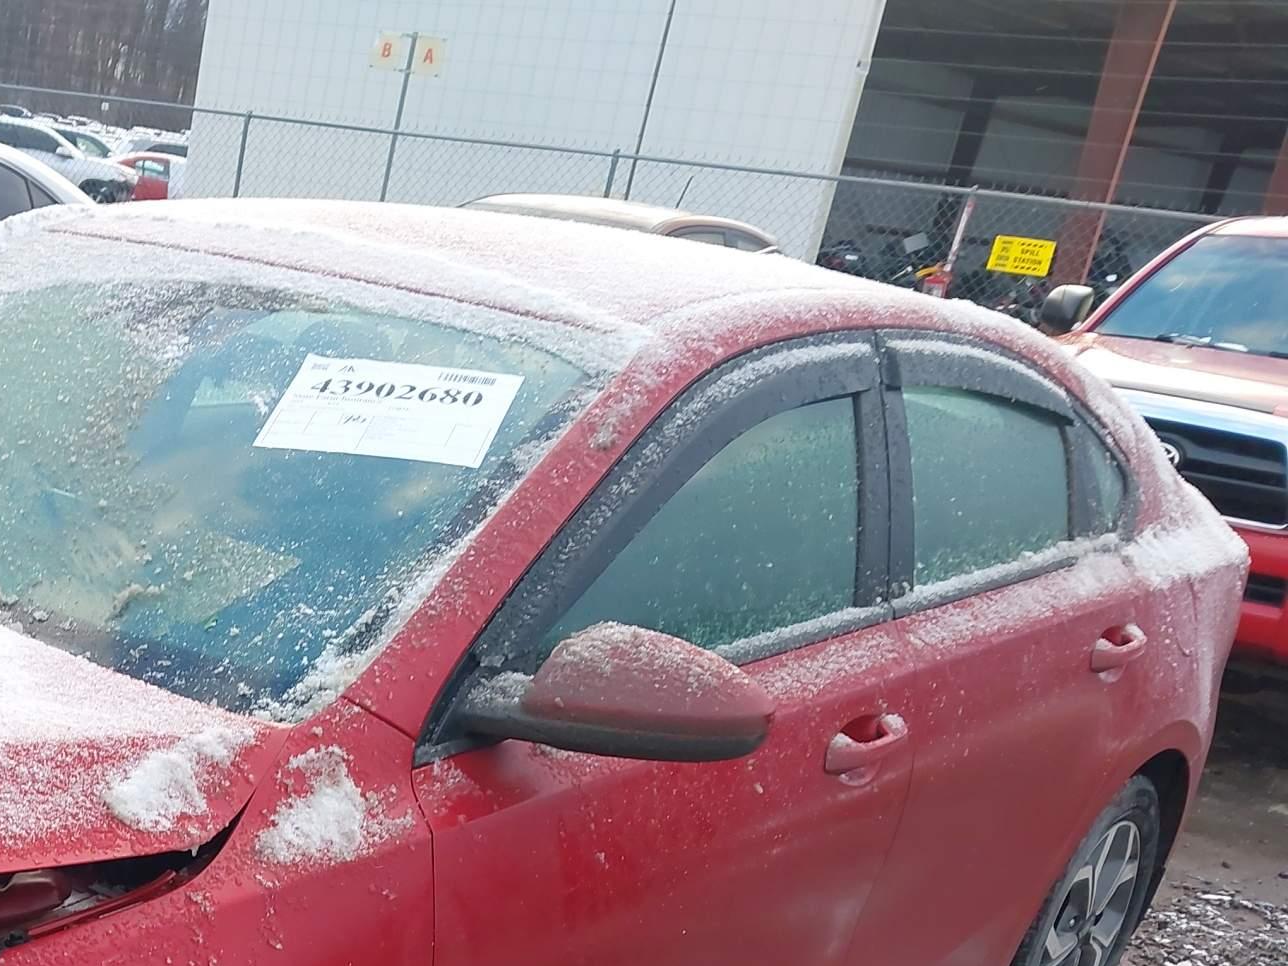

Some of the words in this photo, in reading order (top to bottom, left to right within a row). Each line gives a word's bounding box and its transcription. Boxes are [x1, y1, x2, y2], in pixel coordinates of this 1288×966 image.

[381, 42, 393, 58] B
[423, 48, 433, 64] A
[310, 378, 483, 407] 43902680
